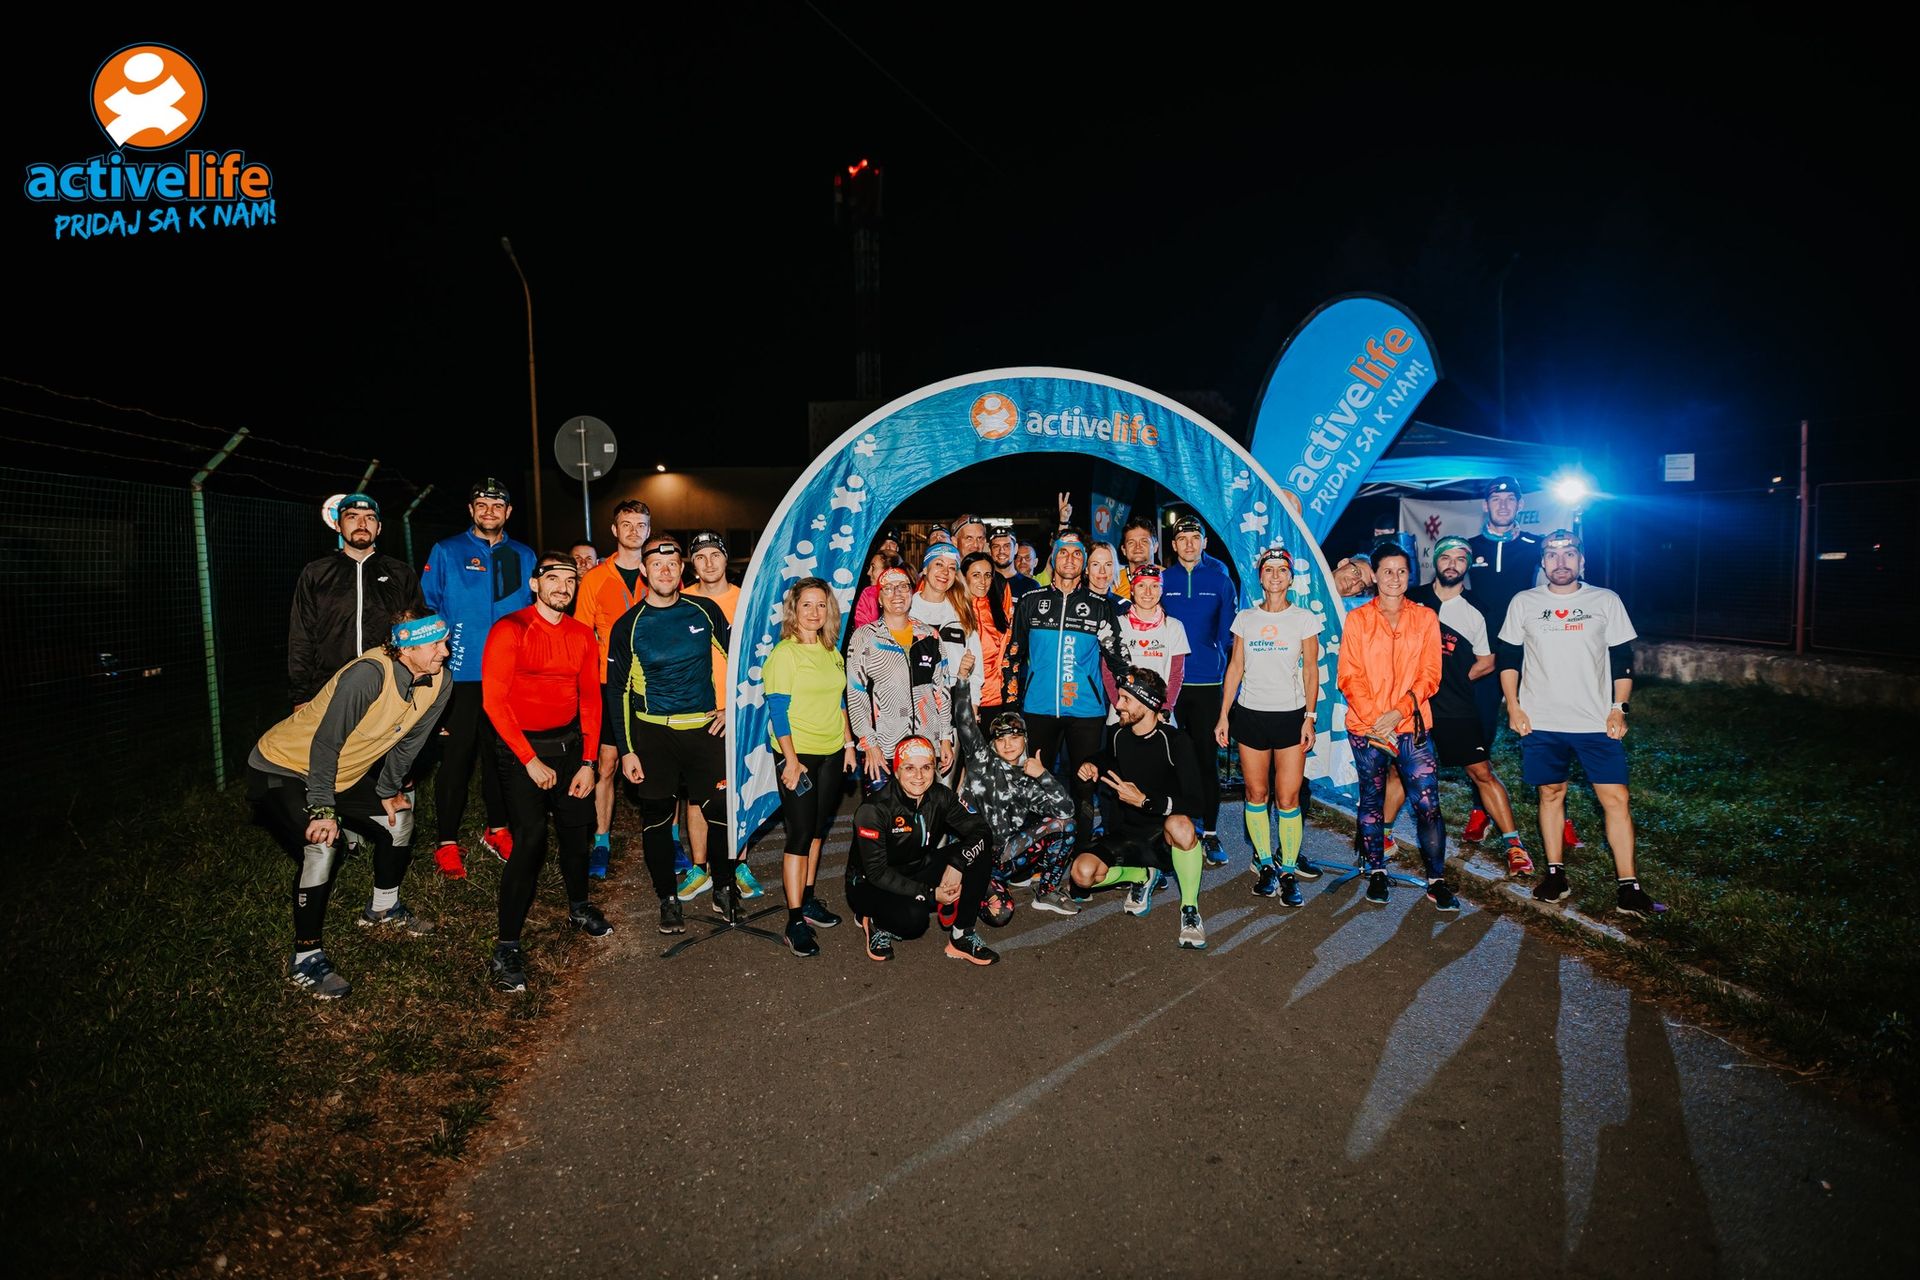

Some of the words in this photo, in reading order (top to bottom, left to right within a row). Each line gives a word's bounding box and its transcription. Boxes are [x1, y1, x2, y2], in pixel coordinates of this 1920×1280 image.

[1026, 406, 1159, 446] activelife
[1288, 327, 1414, 492] activelife
[1310, 450, 1361, 515] PRIDAJ
[1356, 425, 1382, 452] SA
[1374, 406, 1393, 424] K
[1386, 359, 1429, 408] NÁM!
[1516, 510, 1540, 525] TEEL
[1564, 623, 1584, 631] Emil
[453, 646, 466, 672] TEAM
